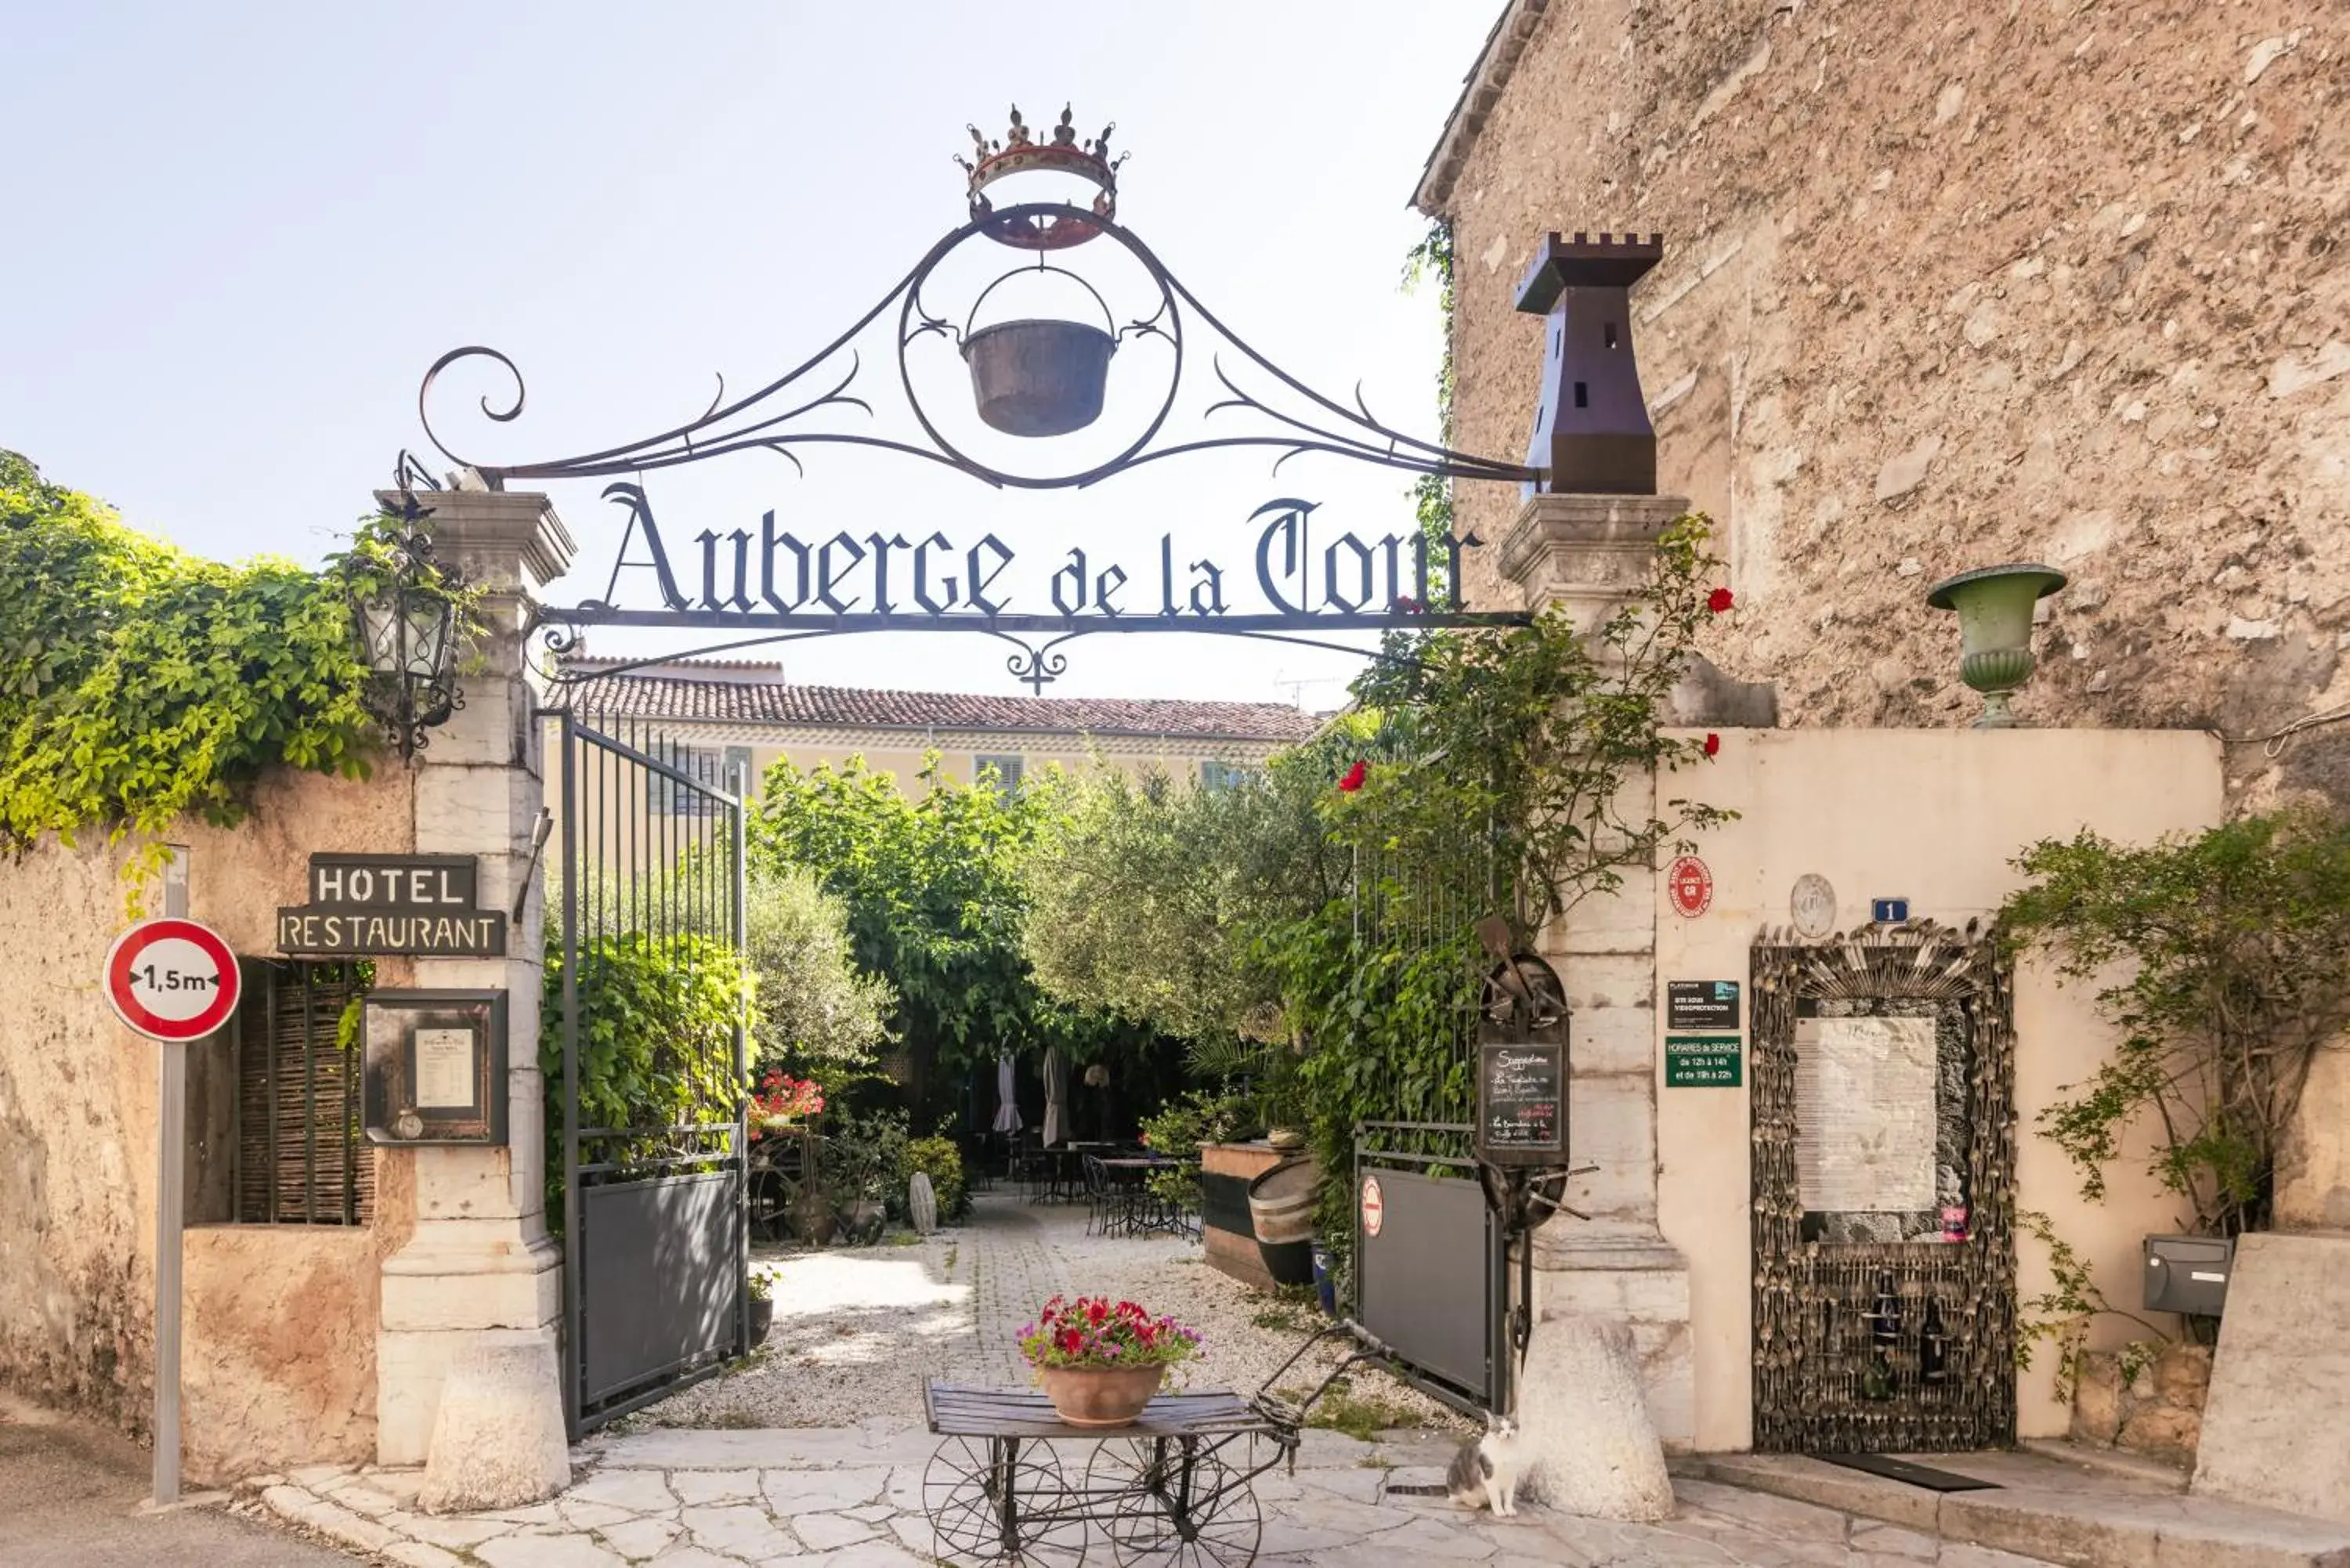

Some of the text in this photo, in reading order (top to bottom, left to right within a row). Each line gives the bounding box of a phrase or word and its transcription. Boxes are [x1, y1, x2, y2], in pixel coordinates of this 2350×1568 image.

[601, 482, 1484, 616] Auberge de la Tour
[319, 869, 464, 903] HOTEL
[1885, 901, 1894, 920] 1
[280, 916, 496, 949] RESTAURANT
[143, 964, 206, 992] 1,5m
[1679, 1057, 1690, 1066] de
